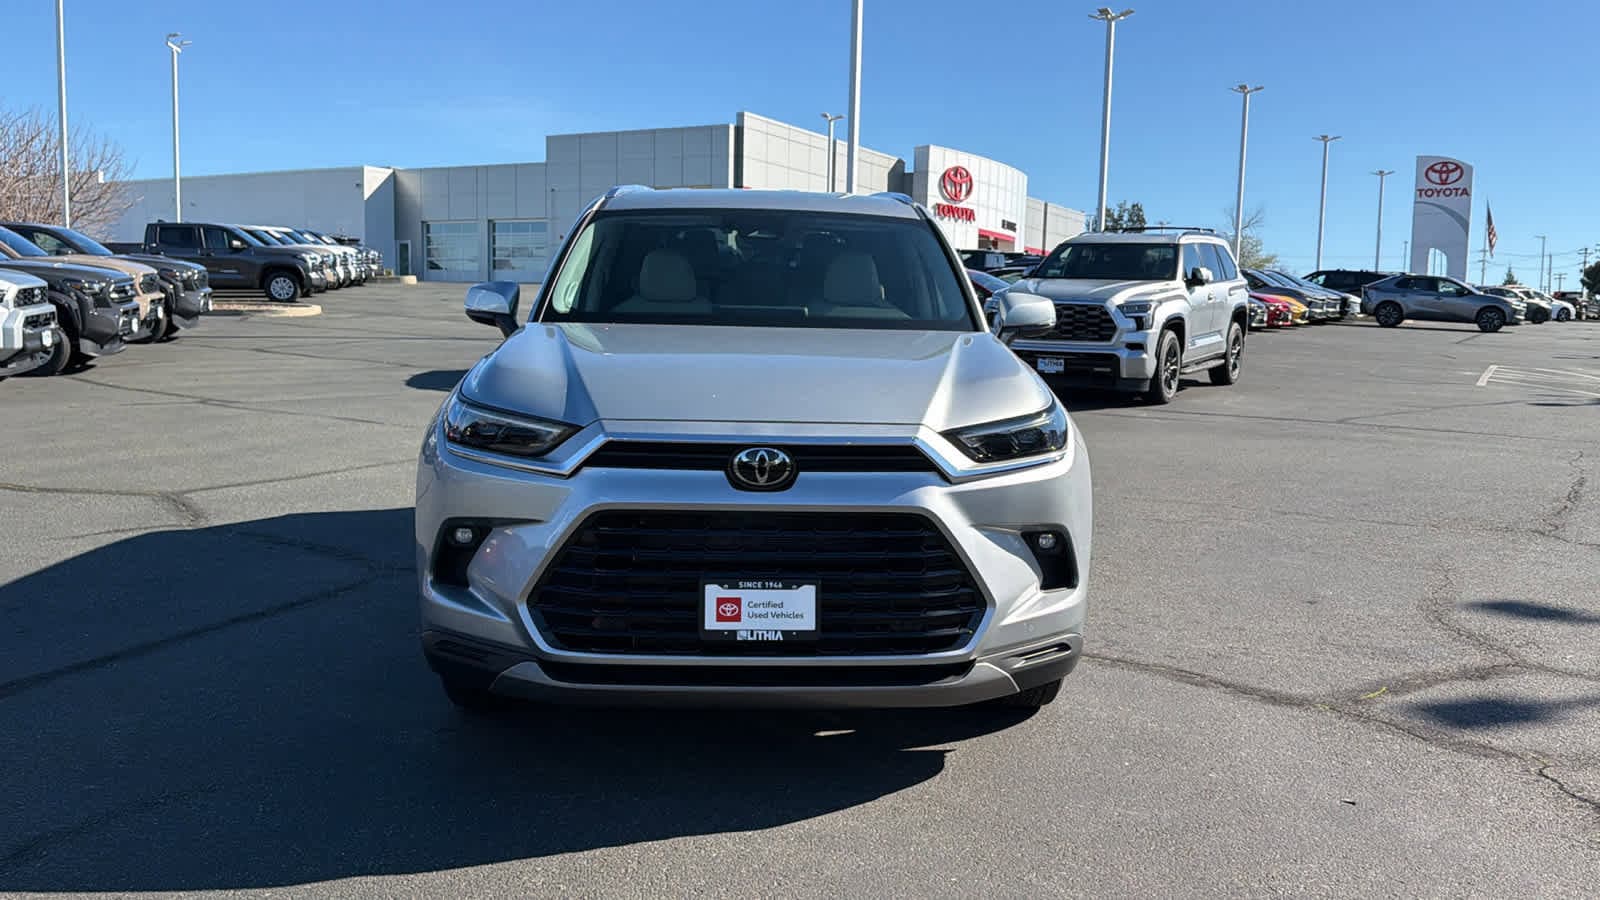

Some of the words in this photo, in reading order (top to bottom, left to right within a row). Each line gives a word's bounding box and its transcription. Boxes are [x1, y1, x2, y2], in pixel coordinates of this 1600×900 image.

[1417, 187, 1470, 198] TOYOTA
[936, 203, 975, 222] TOYOTA
[747, 600, 784, 609] Certified
[747, 611, 769, 619] Used
[771, 611, 804, 619] Vehicles
[747, 630, 784, 641] LITHIA
